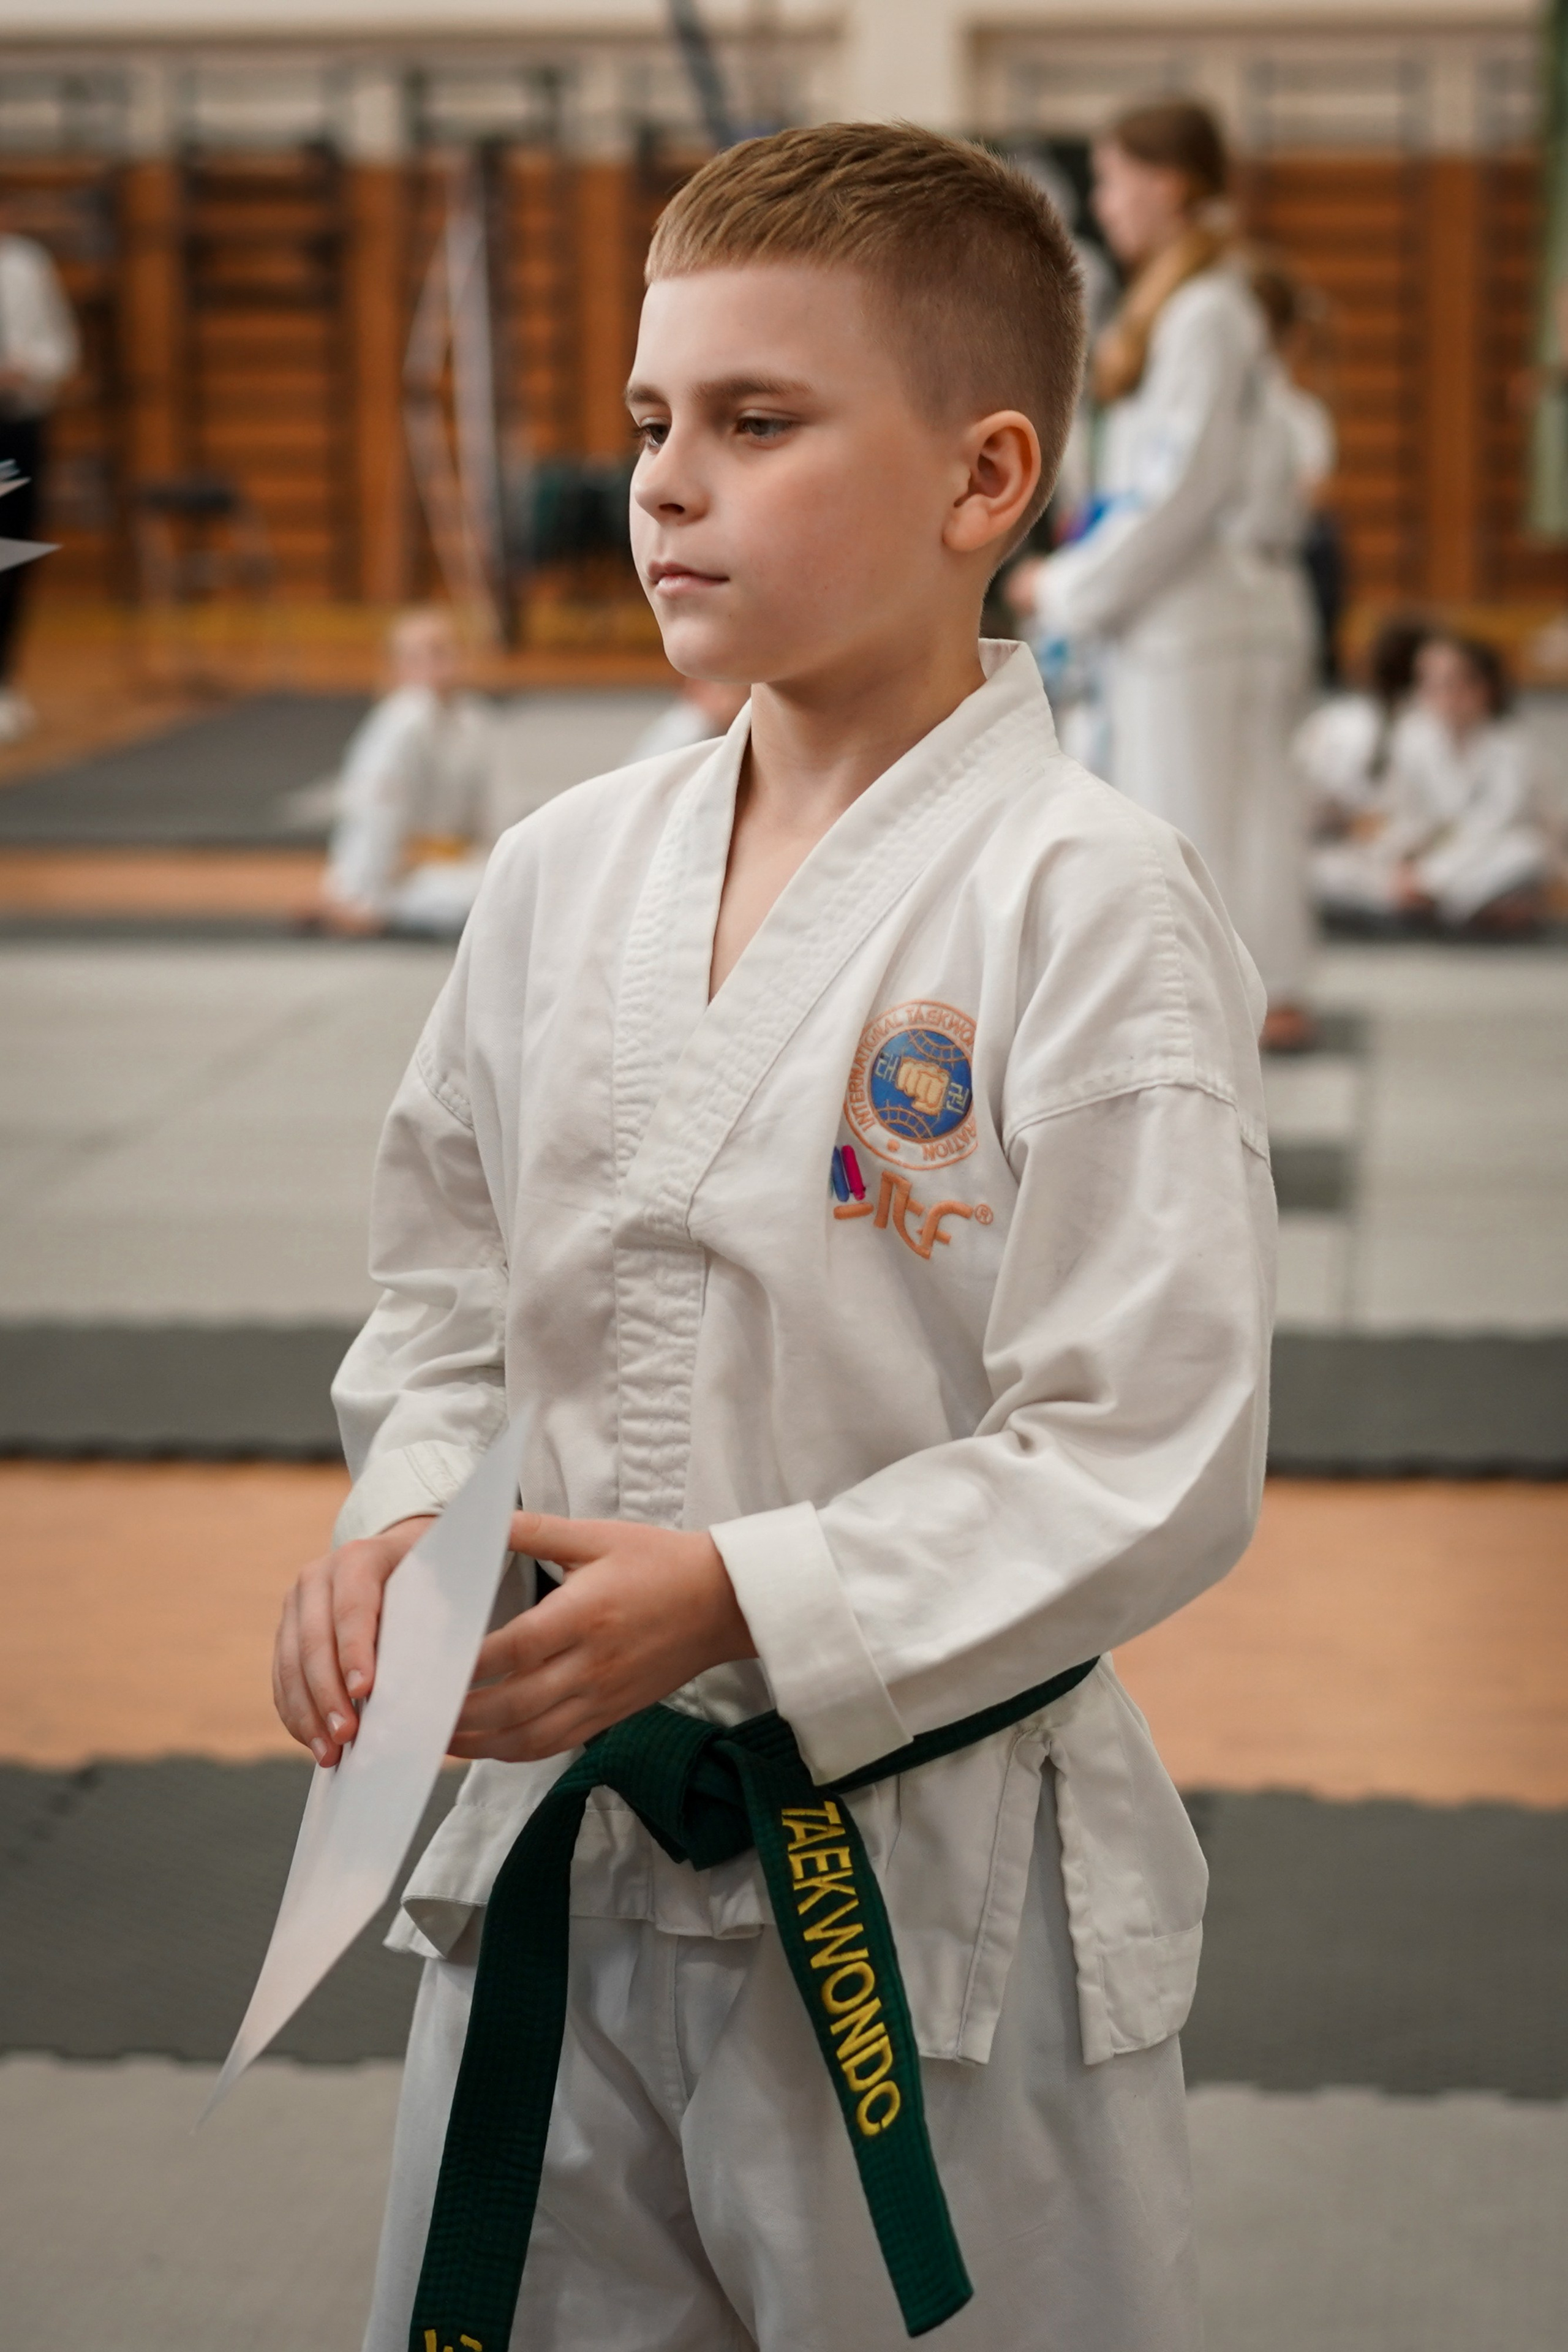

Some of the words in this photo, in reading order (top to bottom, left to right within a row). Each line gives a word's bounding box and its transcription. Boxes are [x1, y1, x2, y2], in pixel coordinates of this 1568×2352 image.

[848, 1012, 903, 1133] INTERNATIONAL
[906, 1006, 976, 1046] TAEKWO
[781, 1800, 901, 2137] TAEKWONDO
